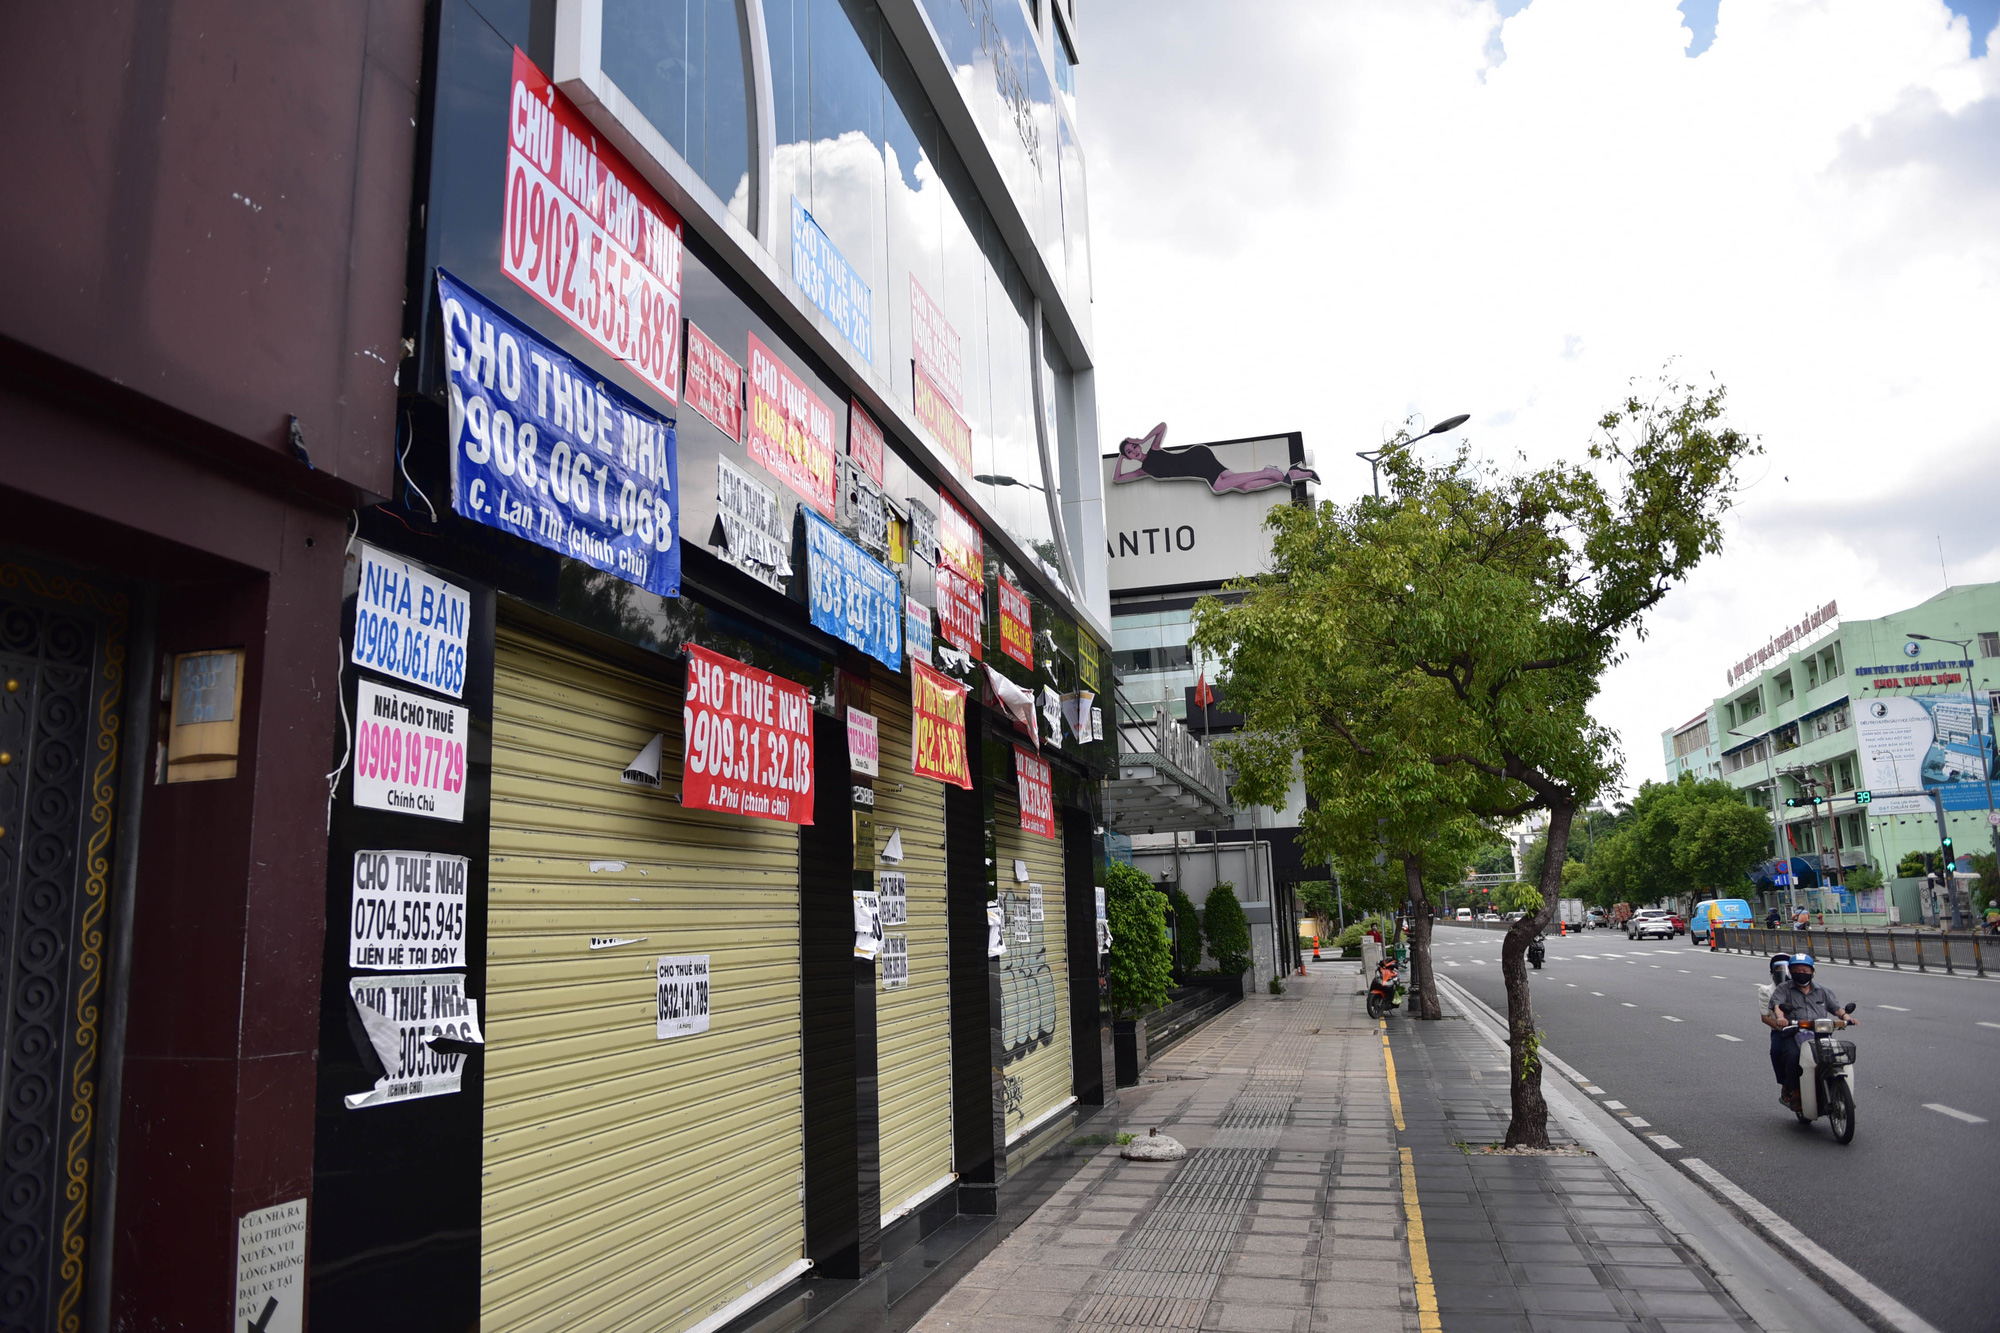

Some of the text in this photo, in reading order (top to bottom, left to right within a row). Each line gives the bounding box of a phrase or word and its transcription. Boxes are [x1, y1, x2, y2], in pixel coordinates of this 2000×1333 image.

[511, 83, 683, 293] CHỦ NHÀ CHO THUÊ
[510, 165, 678, 392] 0902.555.882
[793, 209, 871, 321] CHO THUÊ NHÀ
[794, 241, 872, 360] 0936 445 201
[911, 281, 927, 320] CHO
[690, 334, 704, 360] CHO
[444, 298, 671, 491] CHO THUÊ NHÀ
[753, 349, 778, 400] CHO
[780, 374, 808, 429] THUÊ
[810, 402, 832, 451] NHÀ
[914, 373, 934, 422] CHO
[469, 478, 492, 513] C.
[500, 497, 533, 530] Lan
[567, 520, 614, 568] (chính
[618, 548, 648, 586] chủ)
[365, 561, 464, 640] NHÀ BÁN
[809, 550, 842, 618] 933
[845, 574, 871, 635] 837
[875, 595, 898, 654] 119
[1820, 599, 1838, 624] MINH
[356, 608, 464, 694] 0908.061.068
[1894, 664, 1909, 674] HỌC
[1874, 672, 1962, 690] KHOA KHÁM BỆNH
[374, 694, 454, 735] NHÀ CHO THUÊ
[729, 671, 774, 726] THUÊ
[778, 688, 810, 737] NHÀ
[358, 720, 464, 795] 0909 19 77 29
[387, 789, 435, 812] Chính Chủ
[708, 783, 790, 820] A.Phú (chính chủ)
[1857, 791, 1871, 804] 39
[356, 853, 390, 891] CHO
[395, 852, 432, 894] THUÊ
[355, 897, 463, 942] 0704.505.945
[357, 943, 458, 969] LIÊN HỆ TẠI ĐÂY
[660, 965, 675, 978] CHO
[391, 980, 427, 1022] THUÊ
[659, 980, 708, 1021] 0932.141.789
[241, 1221, 305, 1246] VÀO THƯỜNG
[265, 1207, 286, 1222] NHÀ
[287, 1206, 300, 1217] RA
[278, 1240, 295, 1254] VUI
[240, 1254, 304, 1282] LÒNG KHÔNG
[262, 1281, 275, 1292] XE
[278, 1274, 293, 1288] TẠI
[238, 1302, 259, 1318] ĐÂY
